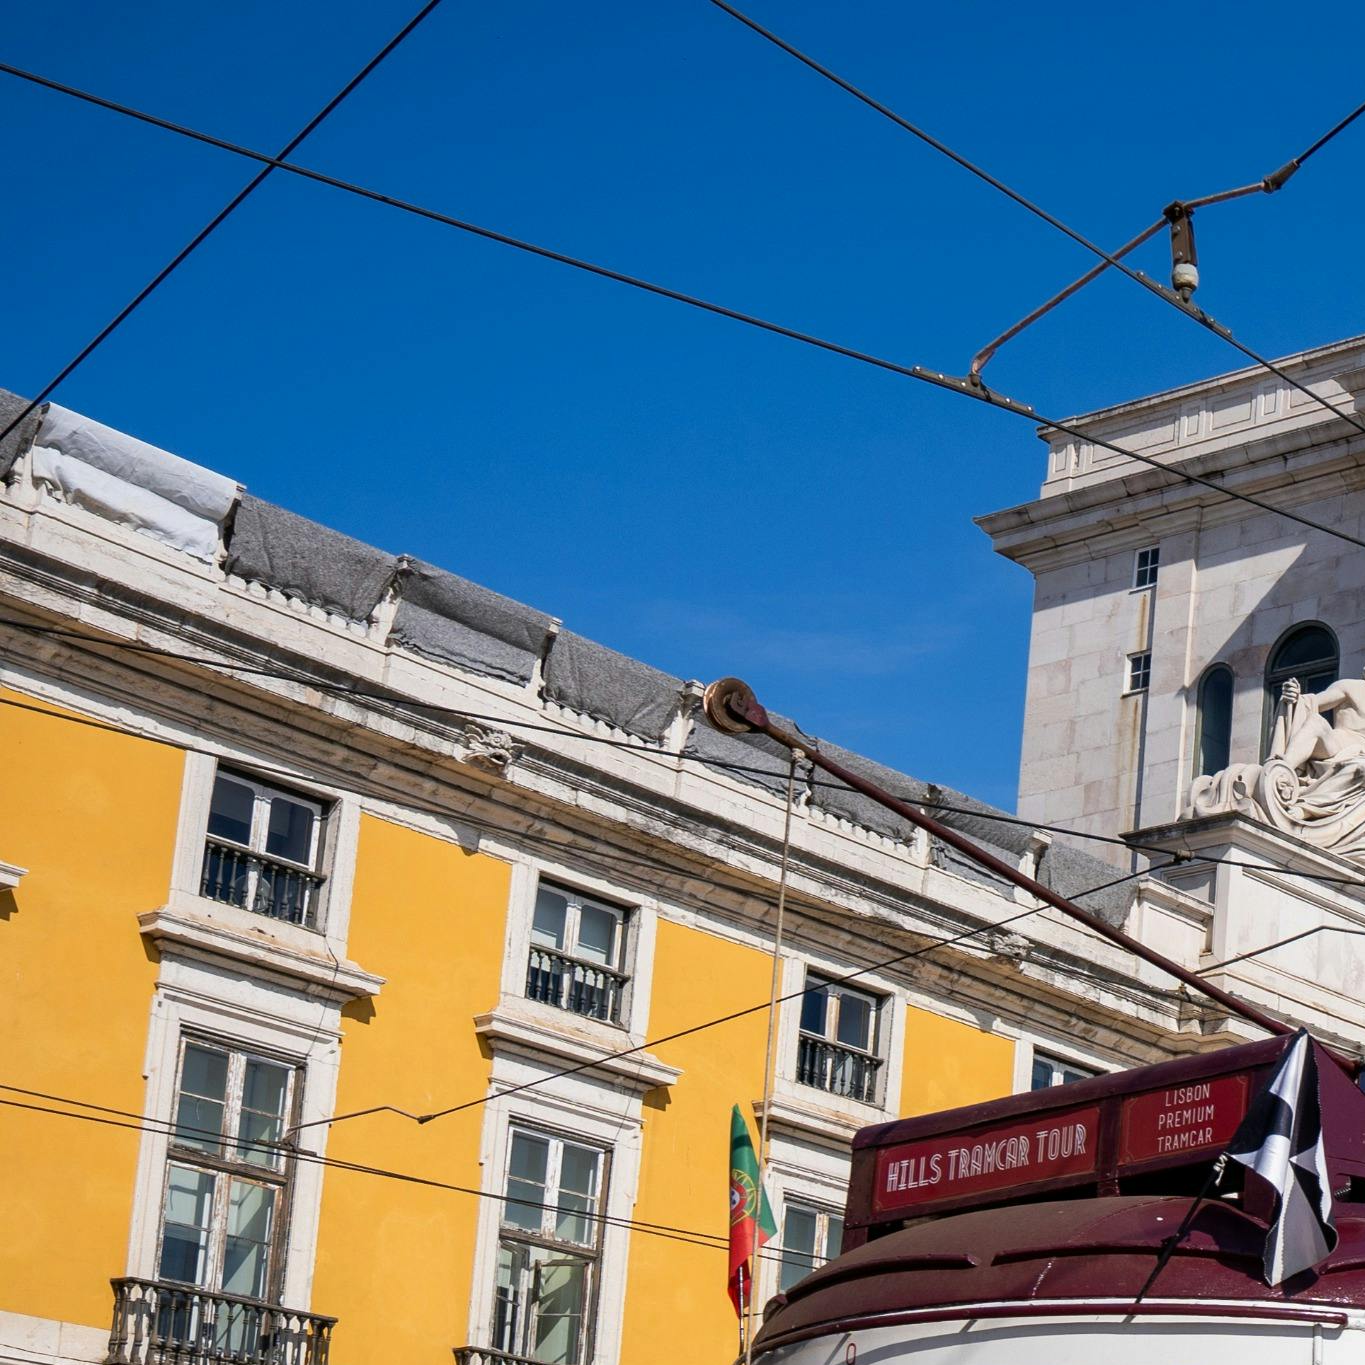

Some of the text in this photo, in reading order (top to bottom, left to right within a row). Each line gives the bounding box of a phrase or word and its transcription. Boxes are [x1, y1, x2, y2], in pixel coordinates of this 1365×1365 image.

[1165, 1083, 1210, 1106] LISBON
[1158, 1104, 1214, 1130] PREMIUM
[1157, 1127, 1213, 1152] TRAMCAR
[886, 1123, 1087, 1193] HILLS TRAMCAR TOUR
